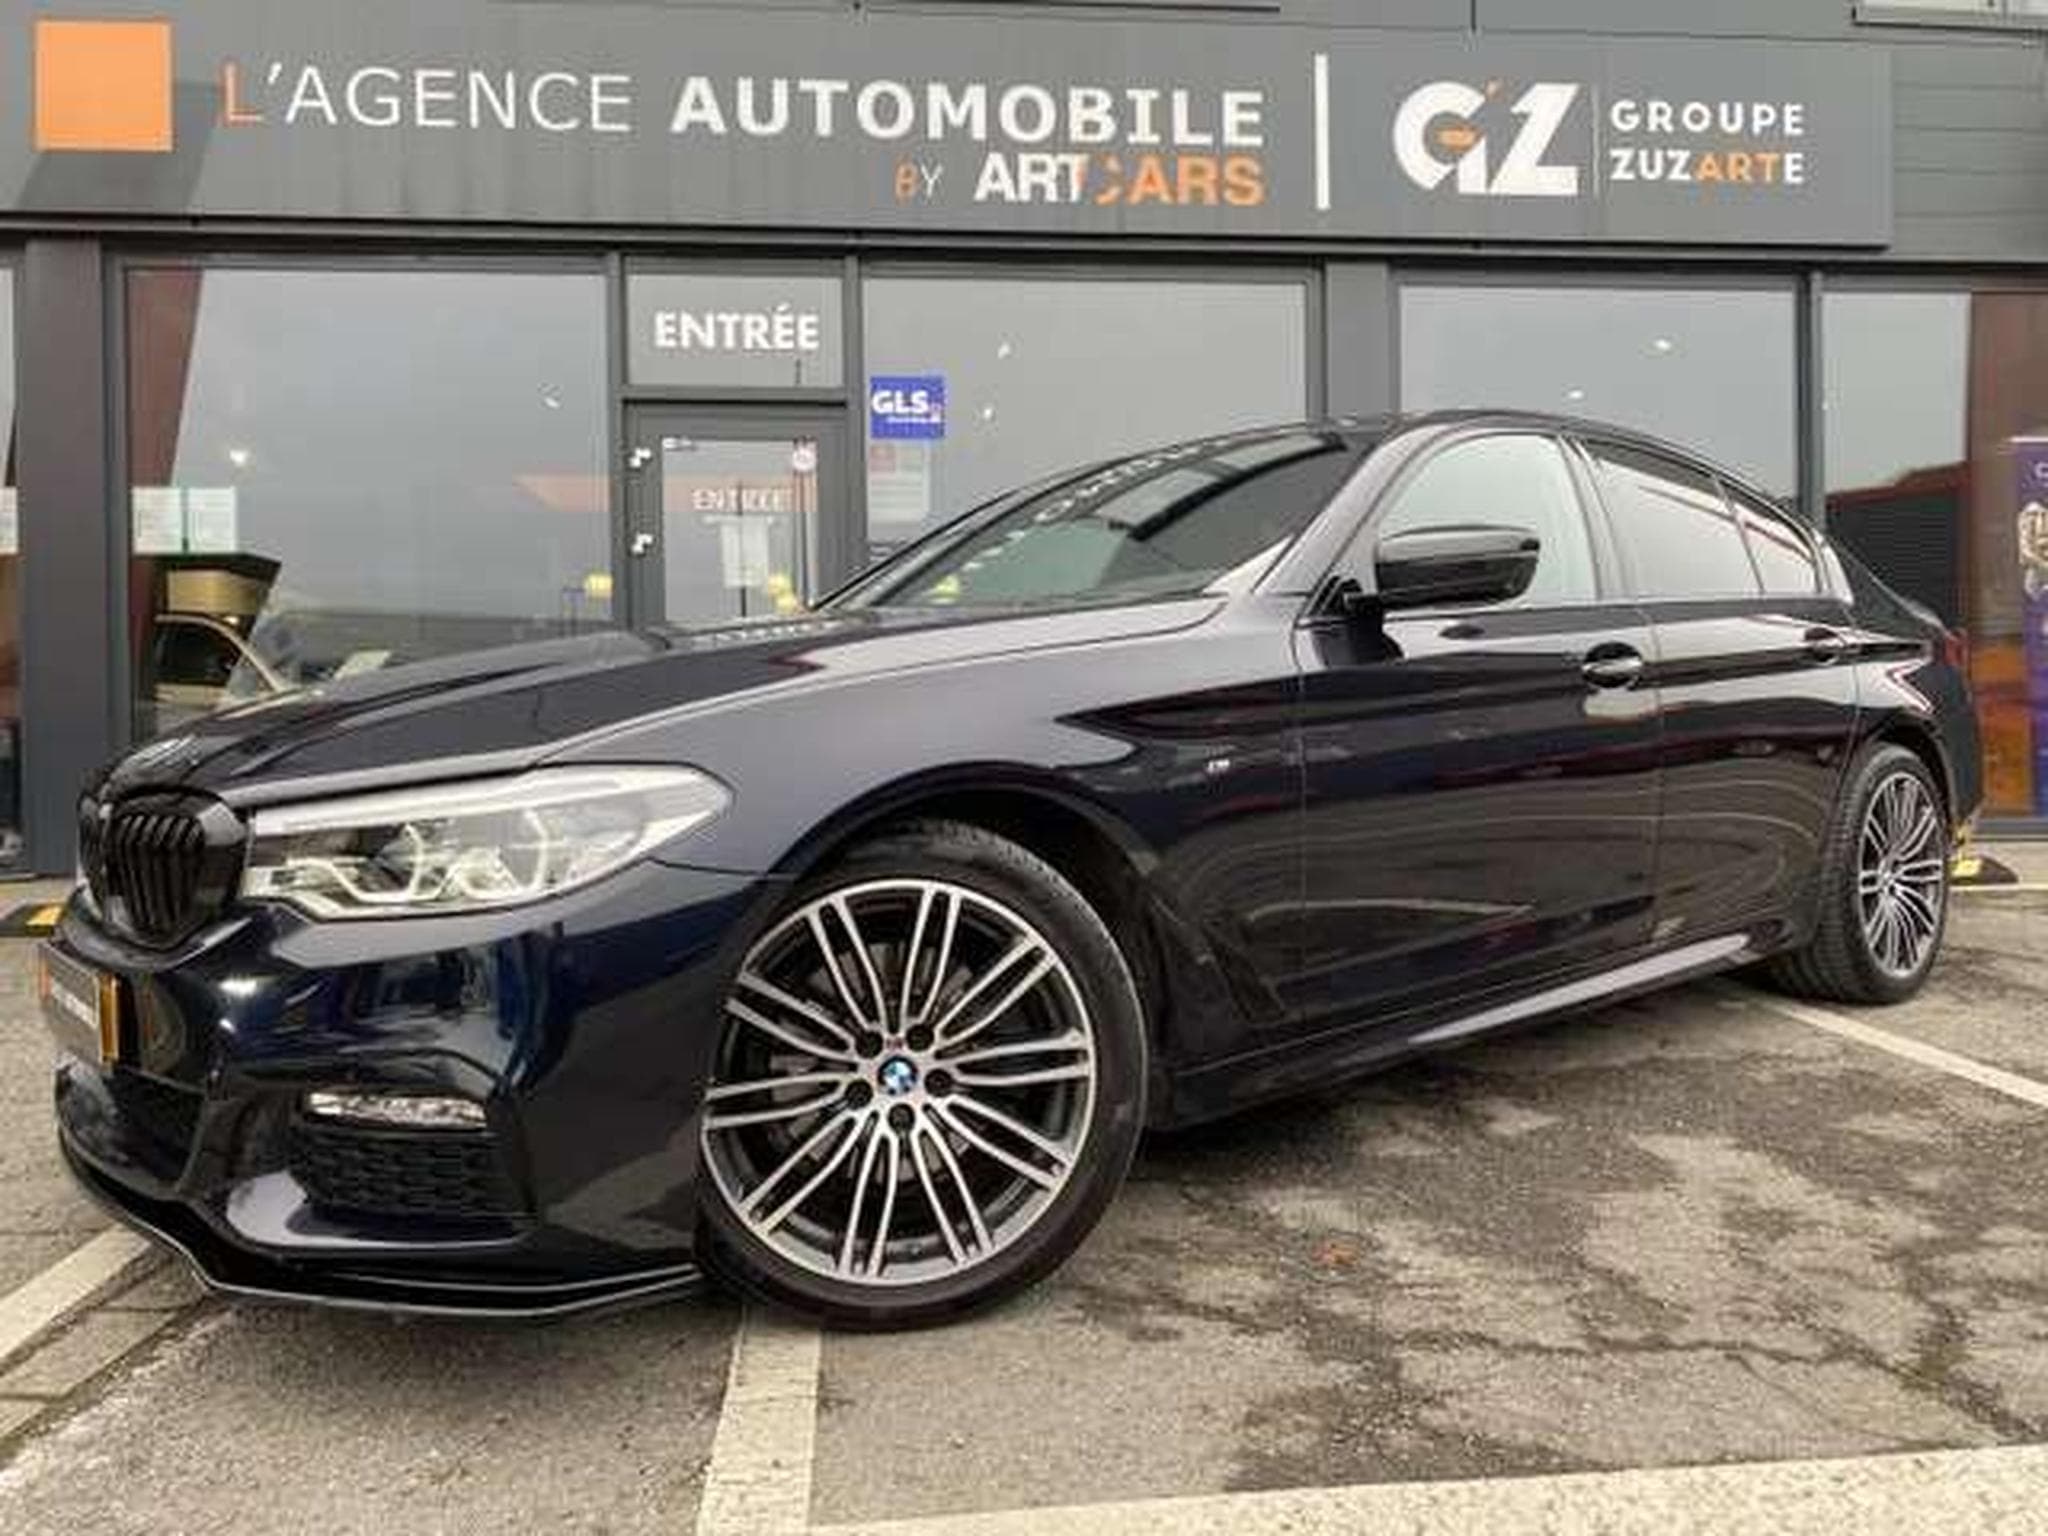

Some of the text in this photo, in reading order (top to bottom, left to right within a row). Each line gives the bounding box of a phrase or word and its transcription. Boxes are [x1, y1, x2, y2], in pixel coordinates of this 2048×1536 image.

[218, 60, 1265, 146] L'AGENCE AUTOMOBILE
[1610, 100, 1804, 136] GROUPE
[1610, 147, 1804, 184] ZUZARTE
[654, 303, 820, 350] ENTRÉE
[872, 389, 929, 414] GLS
